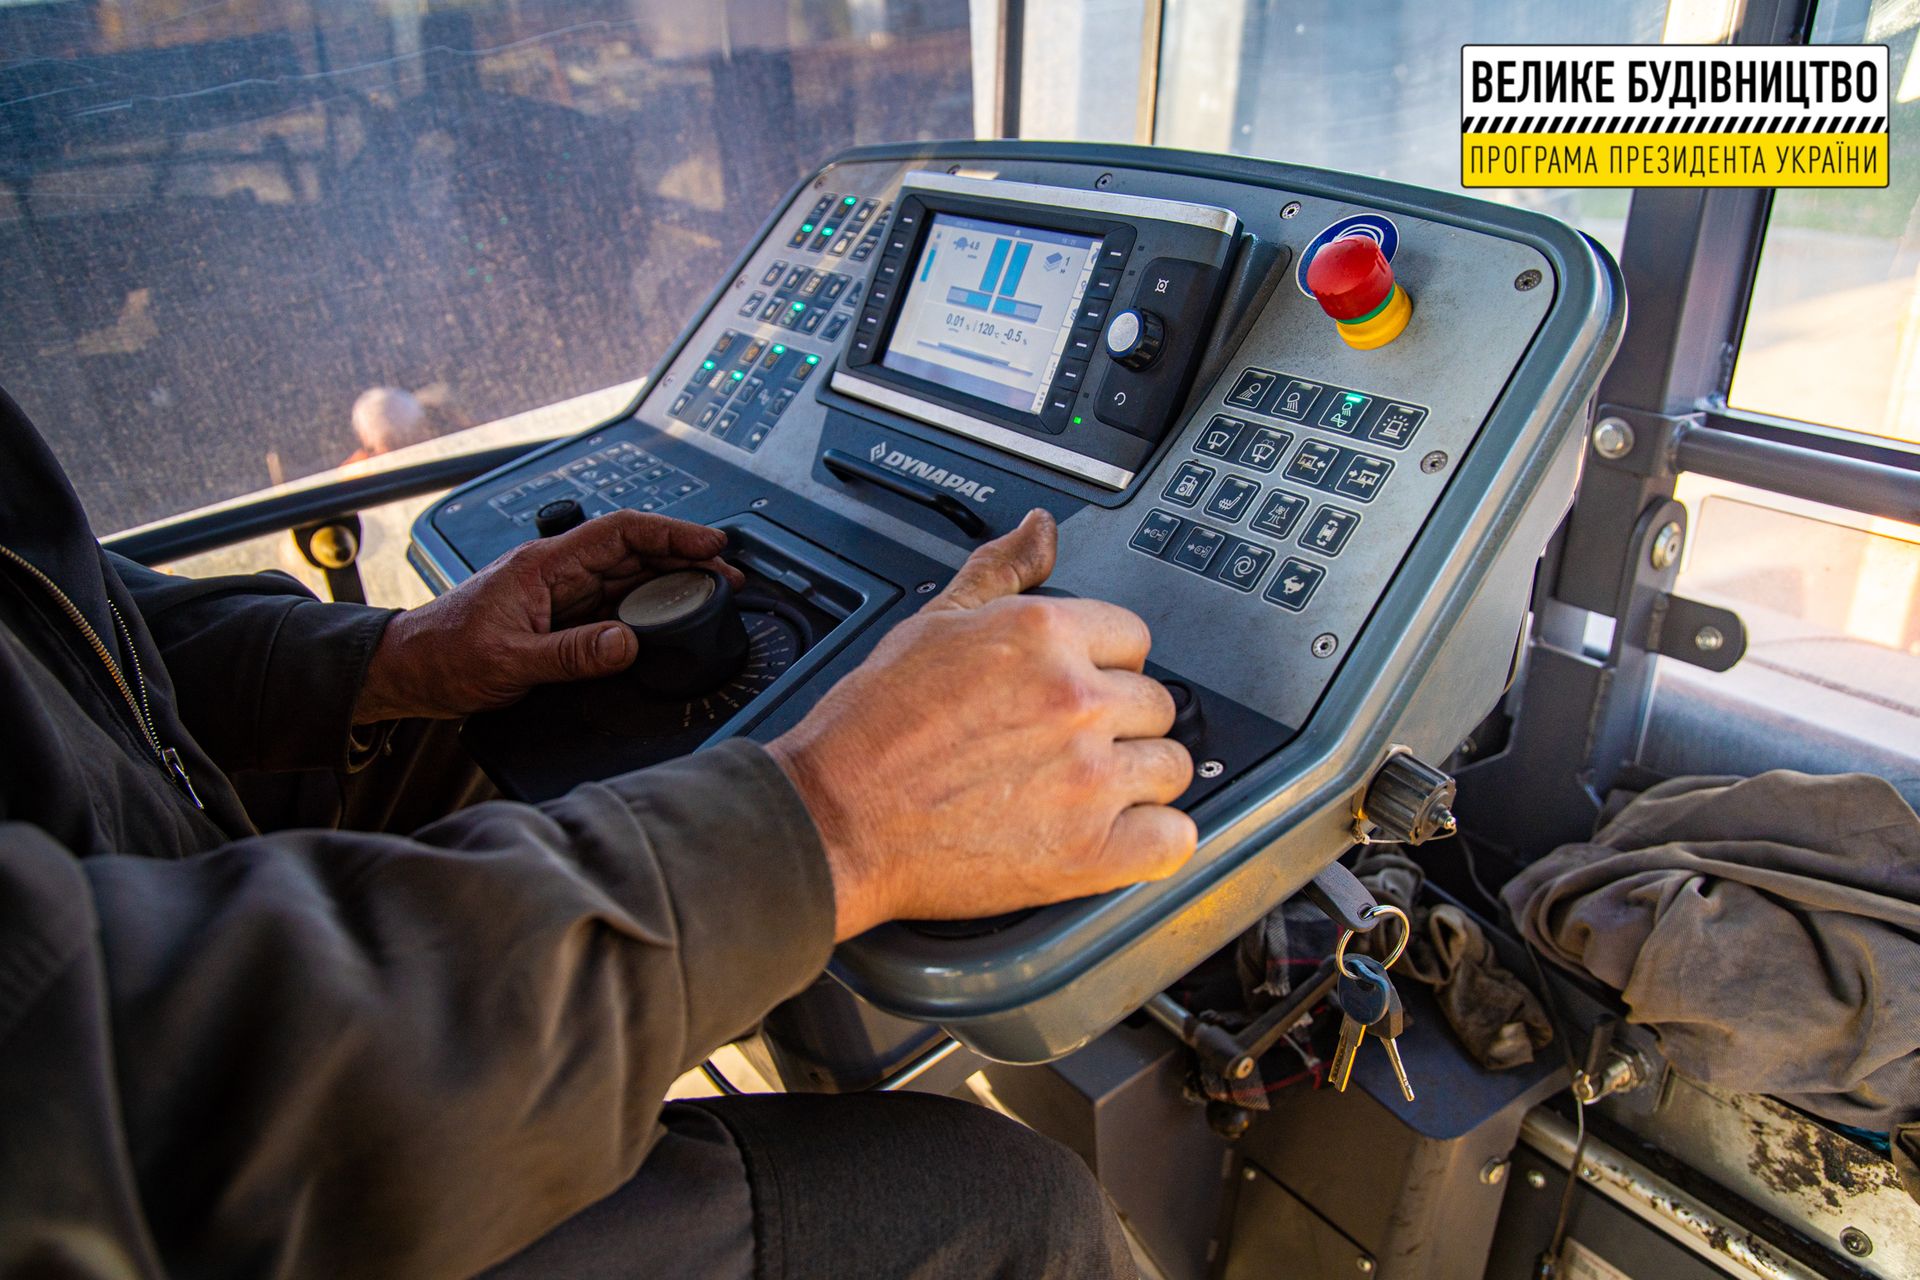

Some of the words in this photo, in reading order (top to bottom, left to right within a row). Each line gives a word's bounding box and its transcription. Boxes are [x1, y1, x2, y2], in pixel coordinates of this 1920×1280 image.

[946, 312, 965, 328] 0.01
[978, 321, 995, 336] 120
[1003, 328, 1023, 343] -0.5
[883, 450, 996, 503] DYNAPAC
